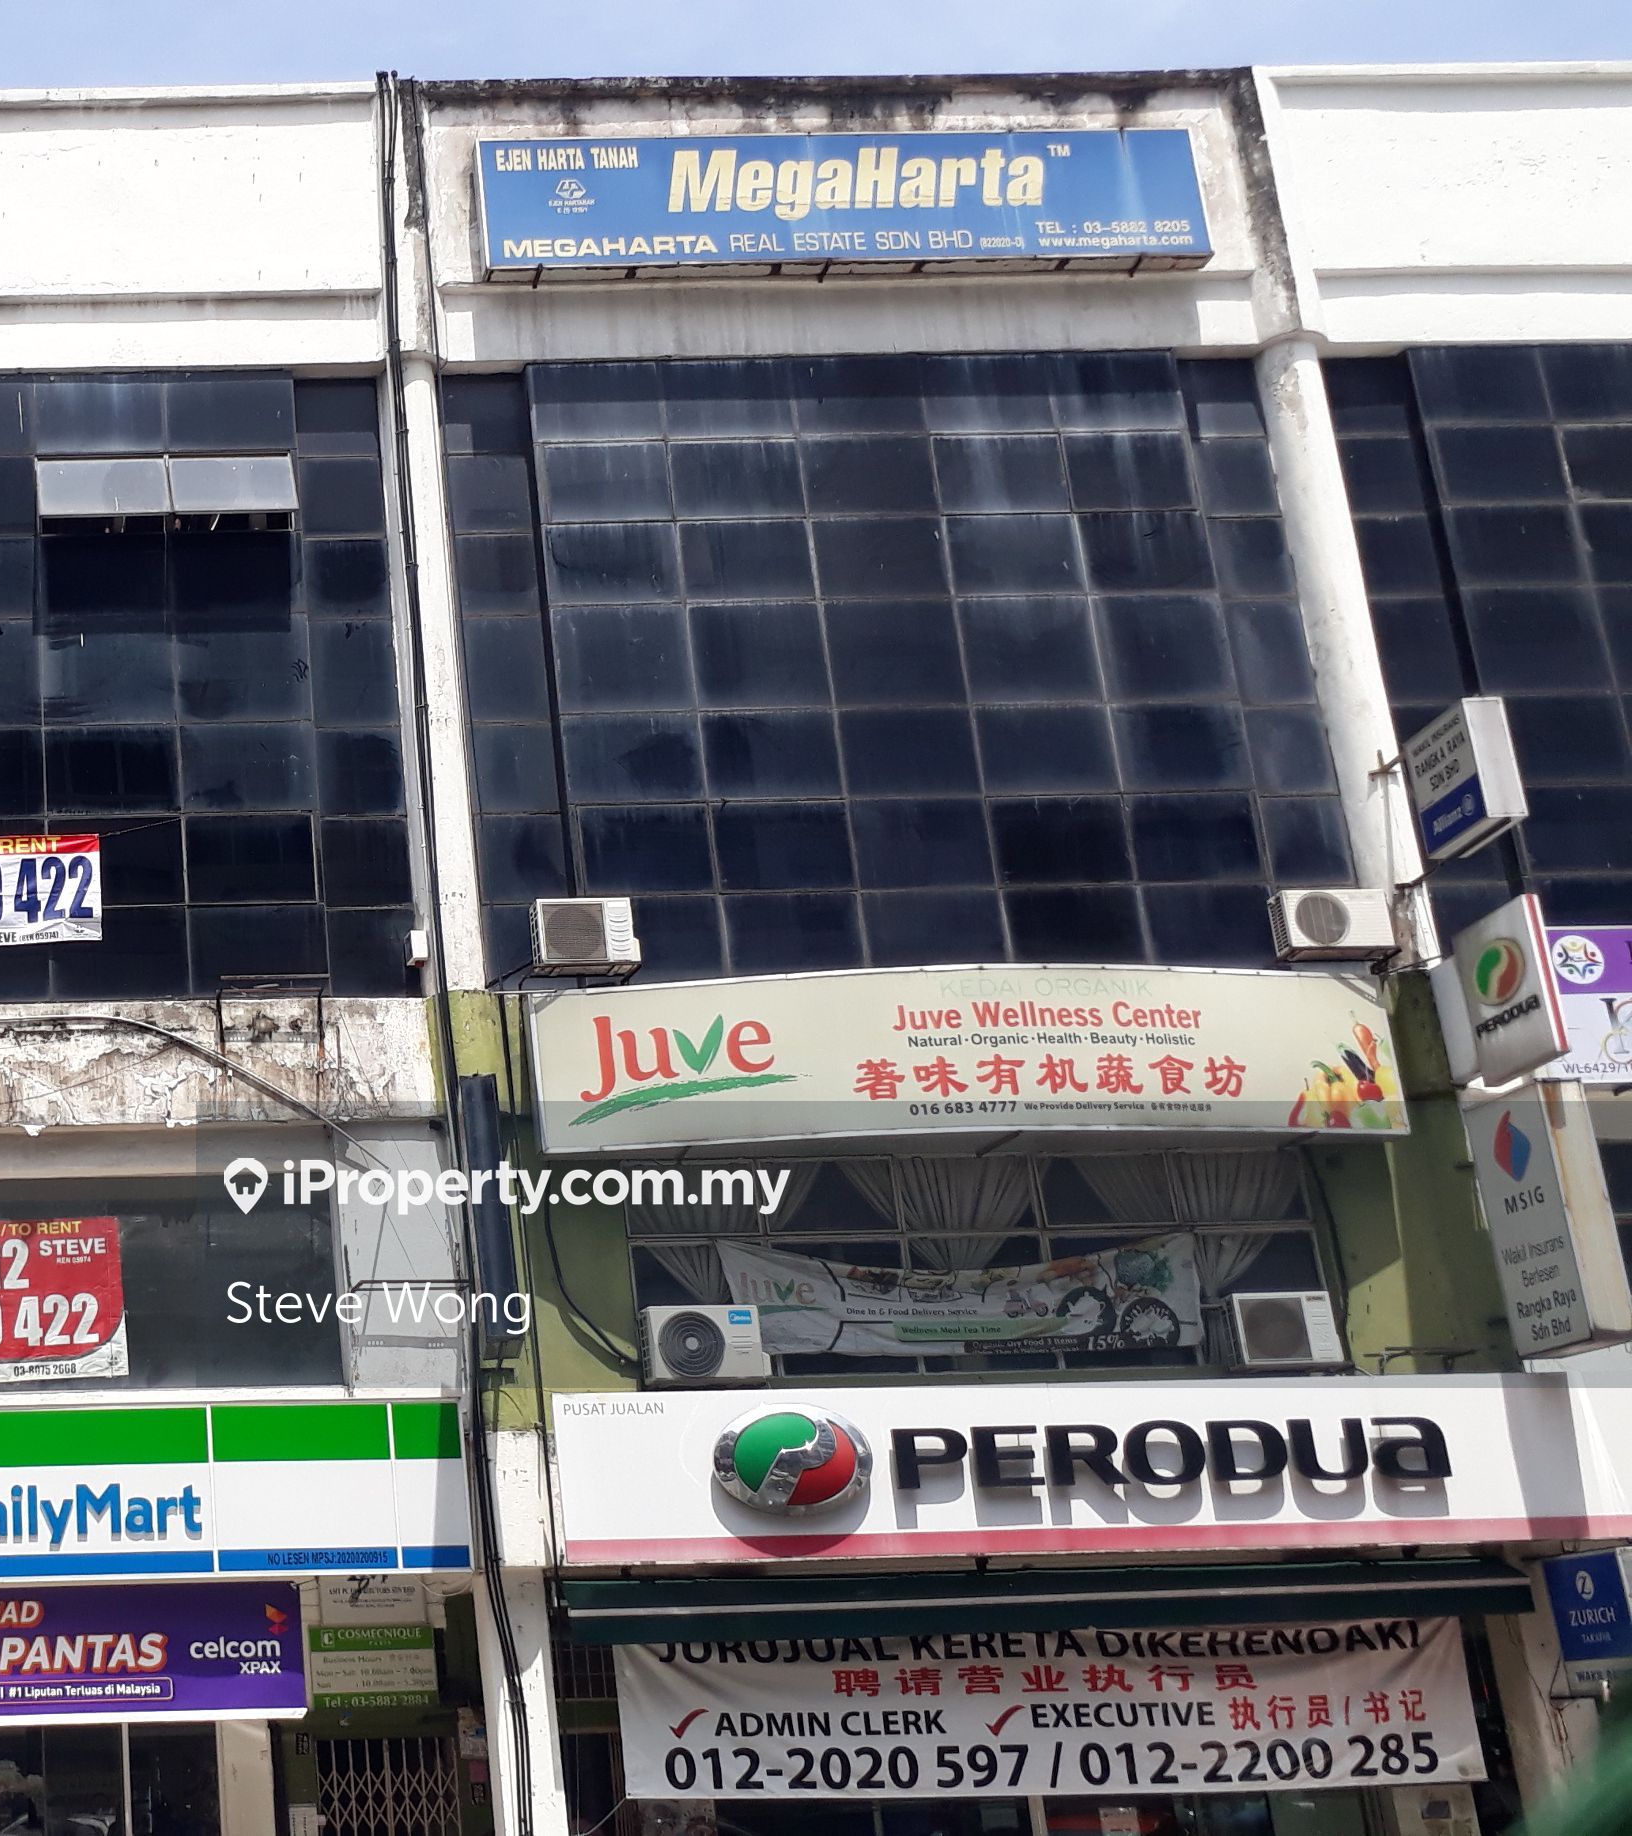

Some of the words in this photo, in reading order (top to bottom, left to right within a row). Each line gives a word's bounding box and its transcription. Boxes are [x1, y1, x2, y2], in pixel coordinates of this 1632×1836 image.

[495, 147, 532, 172] EJEN
[536, 147, 586, 171] HARTA
[590, 146, 639, 169] TANAH
[667, 147, 1045, 221] MegaHarta
[1035, 221, 1065, 234] TEL
[1083, 220, 1148, 233] 03-5882
[1153, 220, 1191, 232] 8205
[503, 235, 718, 259] MEGAHARTA
[728, 232, 785, 253] REAL
[793, 231, 866, 252] ESTATE
[874, 231, 920, 251] SDN
[928, 229, 974, 250] BHD
[1038, 234, 1193, 250] www.megaharta.com
[13, 855, 95, 920] 422
[1033, 976, 1154, 998] ORGANIK
[892, 1004, 963, 1032] Juve
[971, 1001, 1103, 1029] Wellness
[1111, 1000, 1202, 1030] Center
[908, 1033, 962, 1048] Natural
[970, 1031, 1029, 1048] Organic
[1036, 1031, 1083, 1046] Health
[1090, 1031, 1137, 1048] Beauty
[1145, 1031, 1196, 1047] Holistic
[579, 1014, 775, 1102] Juve
[909, 1102, 941, 1117] 016
[943, 1101, 975, 1116] 683
[978, 1099, 1018, 1114] 4777
[1024, 1102, 1039, 1111] We
[1040, 1101, 1075, 1111] Provide
[1076, 1101, 1112, 1112] Delivery
[1114, 1102, 1145, 1111] Service
[1504, 1185, 1545, 1215] MSIG
[10, 1222, 32, 1238] TO
[36, 1220, 82, 1236] RENT
[39, 1237, 107, 1257] STEVE
[888, 1307, 909, 1316] Food
[1516, 1294, 1552, 1320] Rangka
[1553, 1287, 1577, 1310] Raya
[13, 1292, 100, 1347] 422
[1531, 1320, 1550, 1342] Sdn
[1550, 1316, 1572, 1336] Bhd
[940, 1326, 961, 1335] Meal
[963, 1326, 979, 1335] Tea
[980, 1326, 1002, 1335] Time
[1023, 1338, 1044, 1347] Food
[1087, 1334, 1126, 1351] 15%
[562, 1402, 607, 1417] PUSAT
[610, 1401, 665, 1416] JUALAN
[267, 1552, 281, 1566] NO
[282, 1551, 310, 1566] LESEN
[1569, 1606, 1616, 1627] ZURICH
[189, 1636, 281, 1660] celcom
[911, 1629, 1087, 1661] KERETA
[1095, 1619, 1421, 1659] DIKEHENDAKI
[239, 1661, 281, 1675] XPAX
[831, 1663, 1259, 1698] 聘请营业执行员
[8, 1686, 23, 1699] #1
[24, 1685, 63, 1701] Liputan
[65, 1684, 104, 1698] Terluas
[104, 1684, 115, 1697] di
[116, 1683, 161, 1699] Malaysia
[323, 1696, 342, 1708] Tel
[714, 1710, 831, 1738] ADMIN
[840, 1708, 948, 1738] CLERK
[1030, 1700, 1216, 1730] EXECUTIVE
[665, 1744, 920, 1790] 012-2020
[935, 1744, 1030, 1789] 597
[1050, 1740, 1064, 1789] /
[1078, 1736, 1334, 1786] 012-2200
[1347, 1731, 1440, 1777] 285
